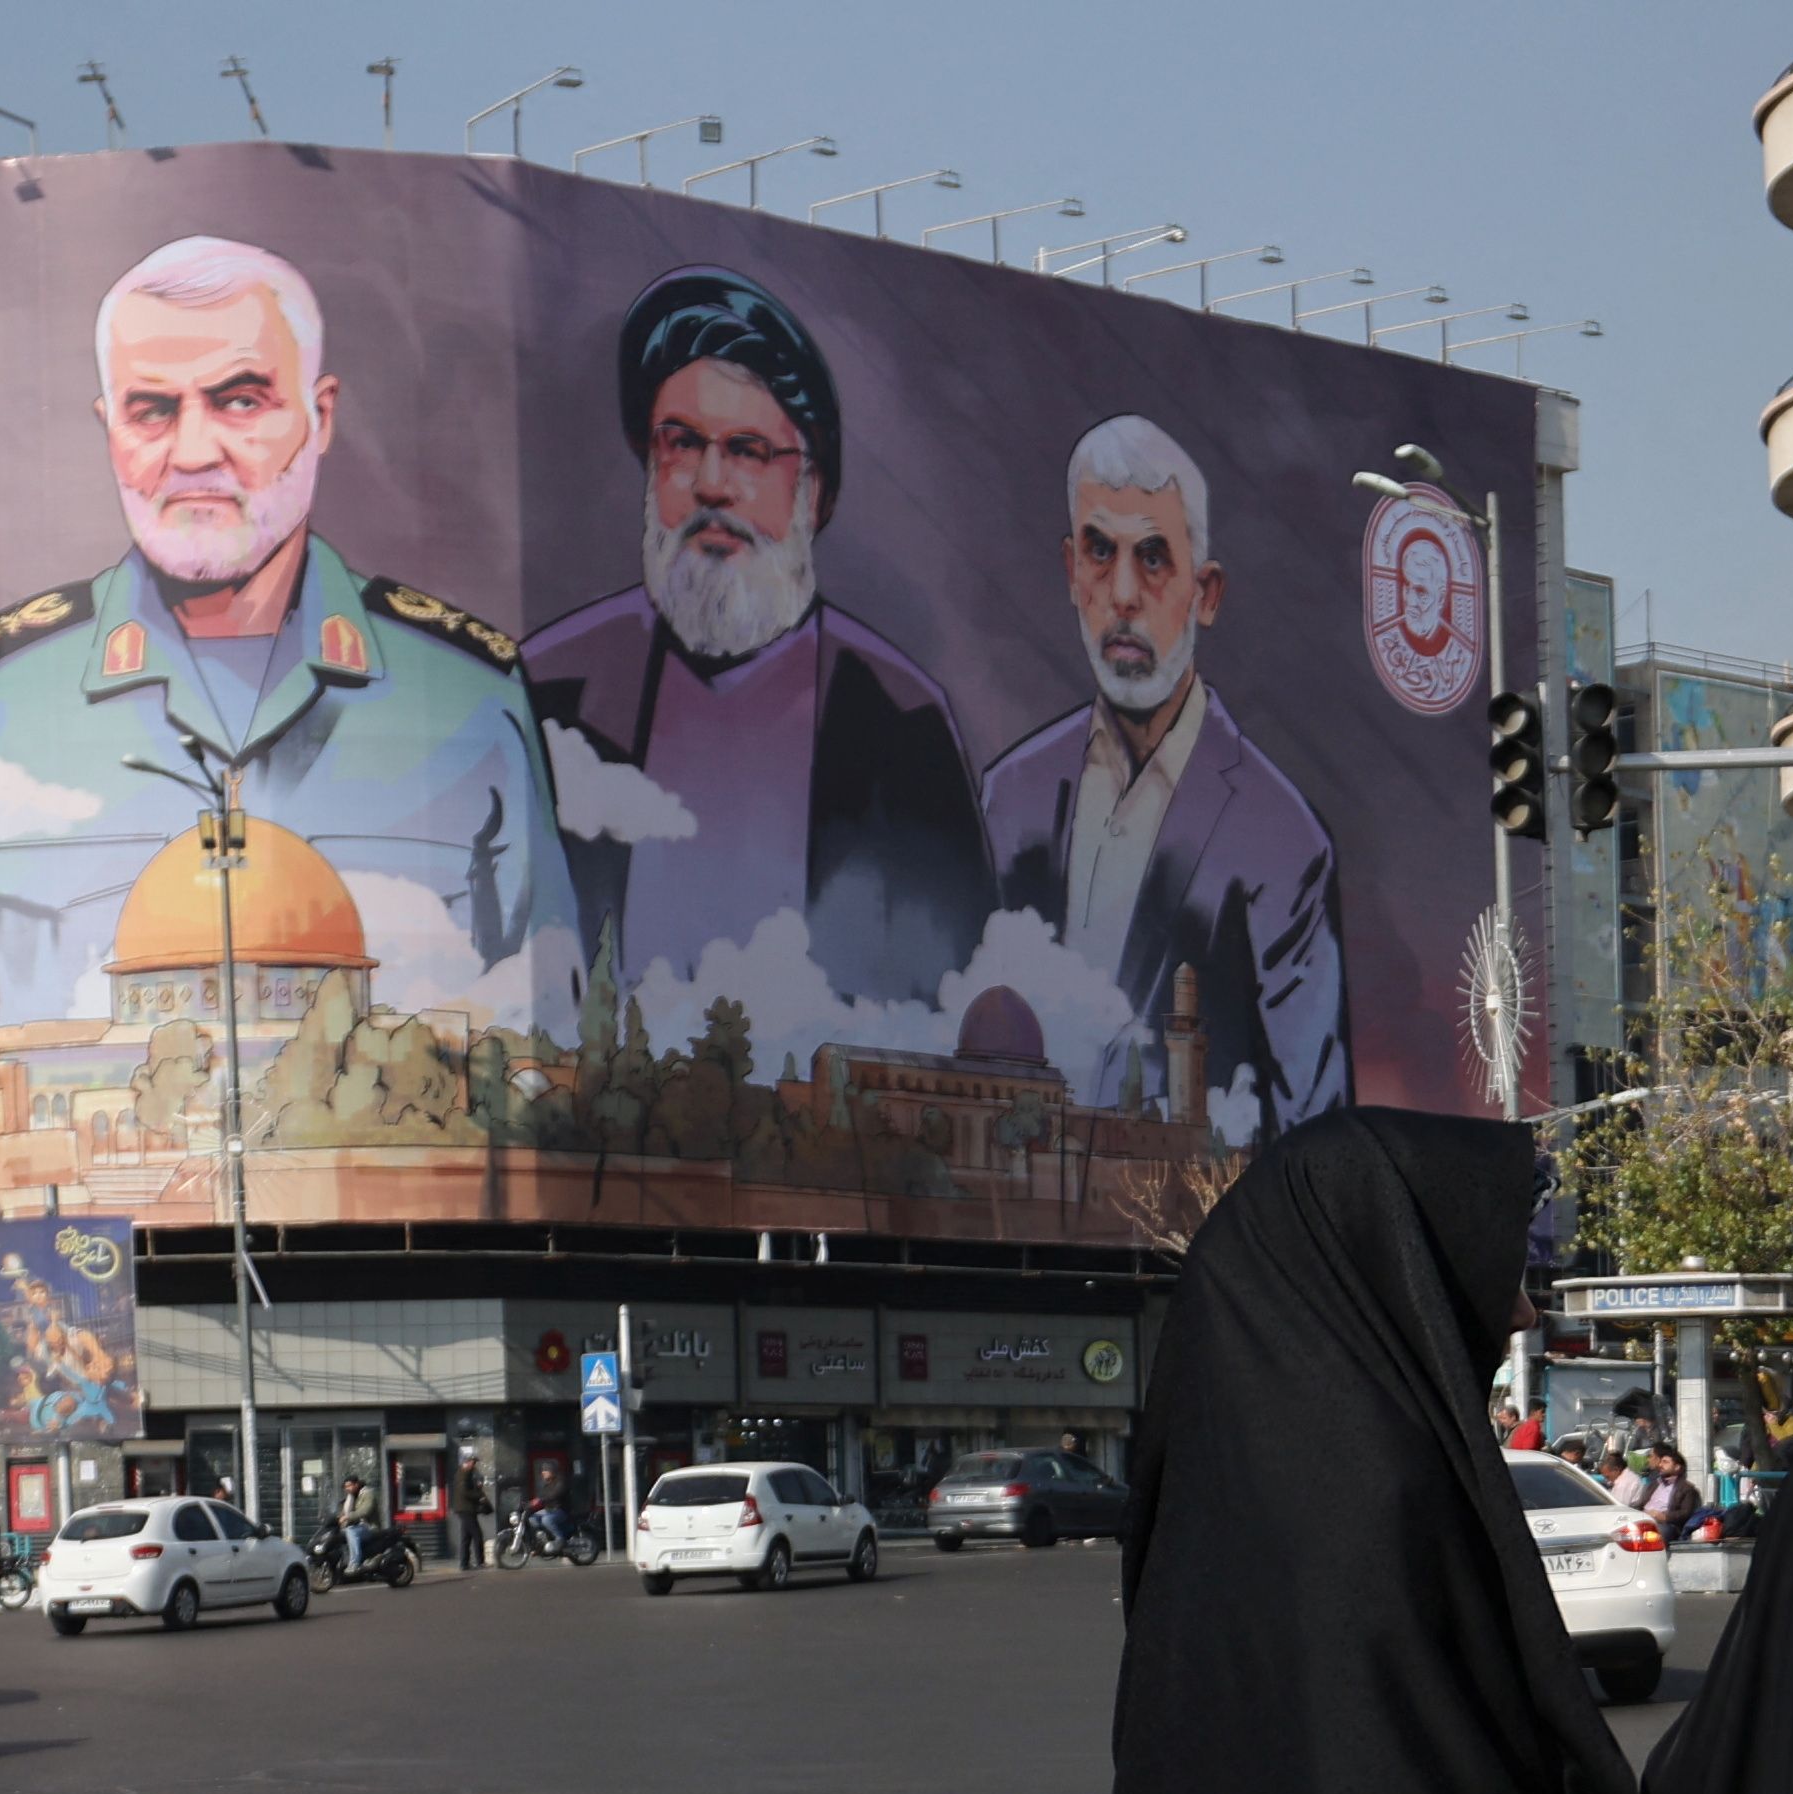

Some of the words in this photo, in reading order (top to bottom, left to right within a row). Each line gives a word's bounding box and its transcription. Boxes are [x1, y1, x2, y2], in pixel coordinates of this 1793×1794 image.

[1594, 1287, 1659, 1306] POLICE
[656, 1329, 711, 1368] بانک
[979, 1337, 1010, 1361] ملی
[1010, 1335, 1051, 1363] کفش
[811, 1352, 867, 1375] ساعتی
